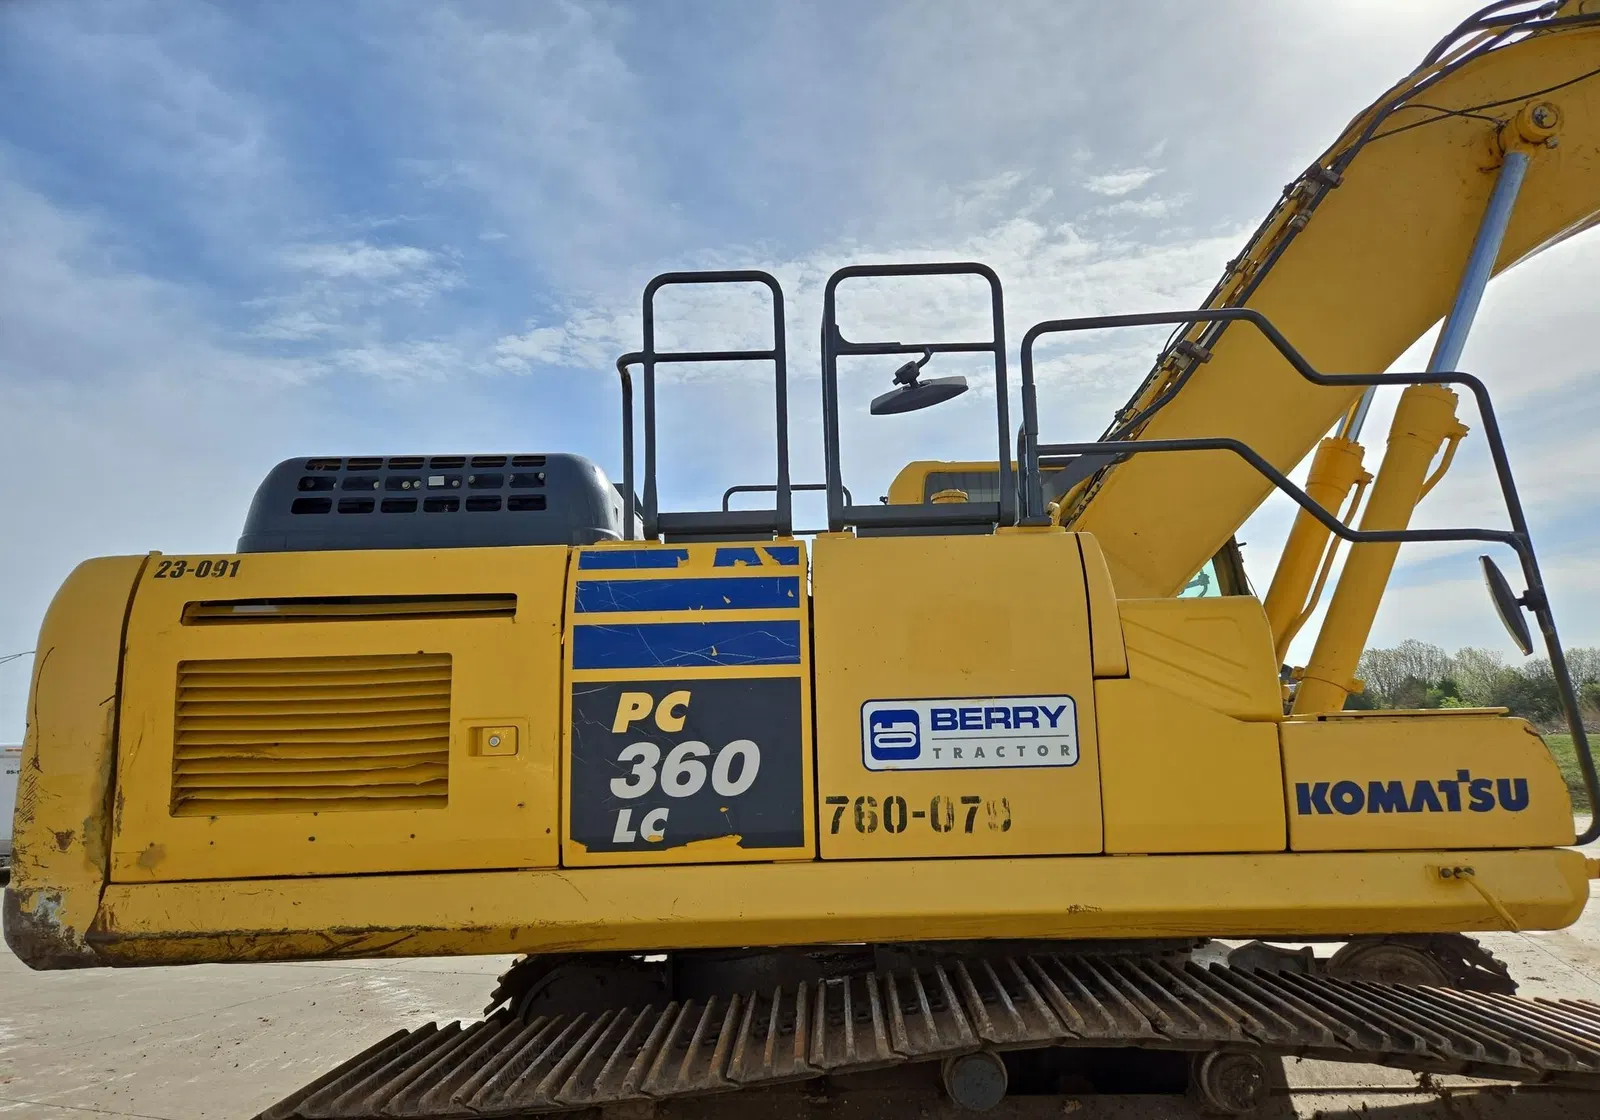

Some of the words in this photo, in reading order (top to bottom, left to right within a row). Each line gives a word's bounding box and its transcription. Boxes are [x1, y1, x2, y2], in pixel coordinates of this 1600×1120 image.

[154, 560, 241, 578] 23-091
[612, 690, 692, 733] PC
[930, 705, 1067, 731] BERRY
[609, 739, 761, 799] 360
[932, 744, 1071, 760] TRACTOR
[1295, 769, 1529, 815] KOMATSU
[612, 807, 670, 843] LC
